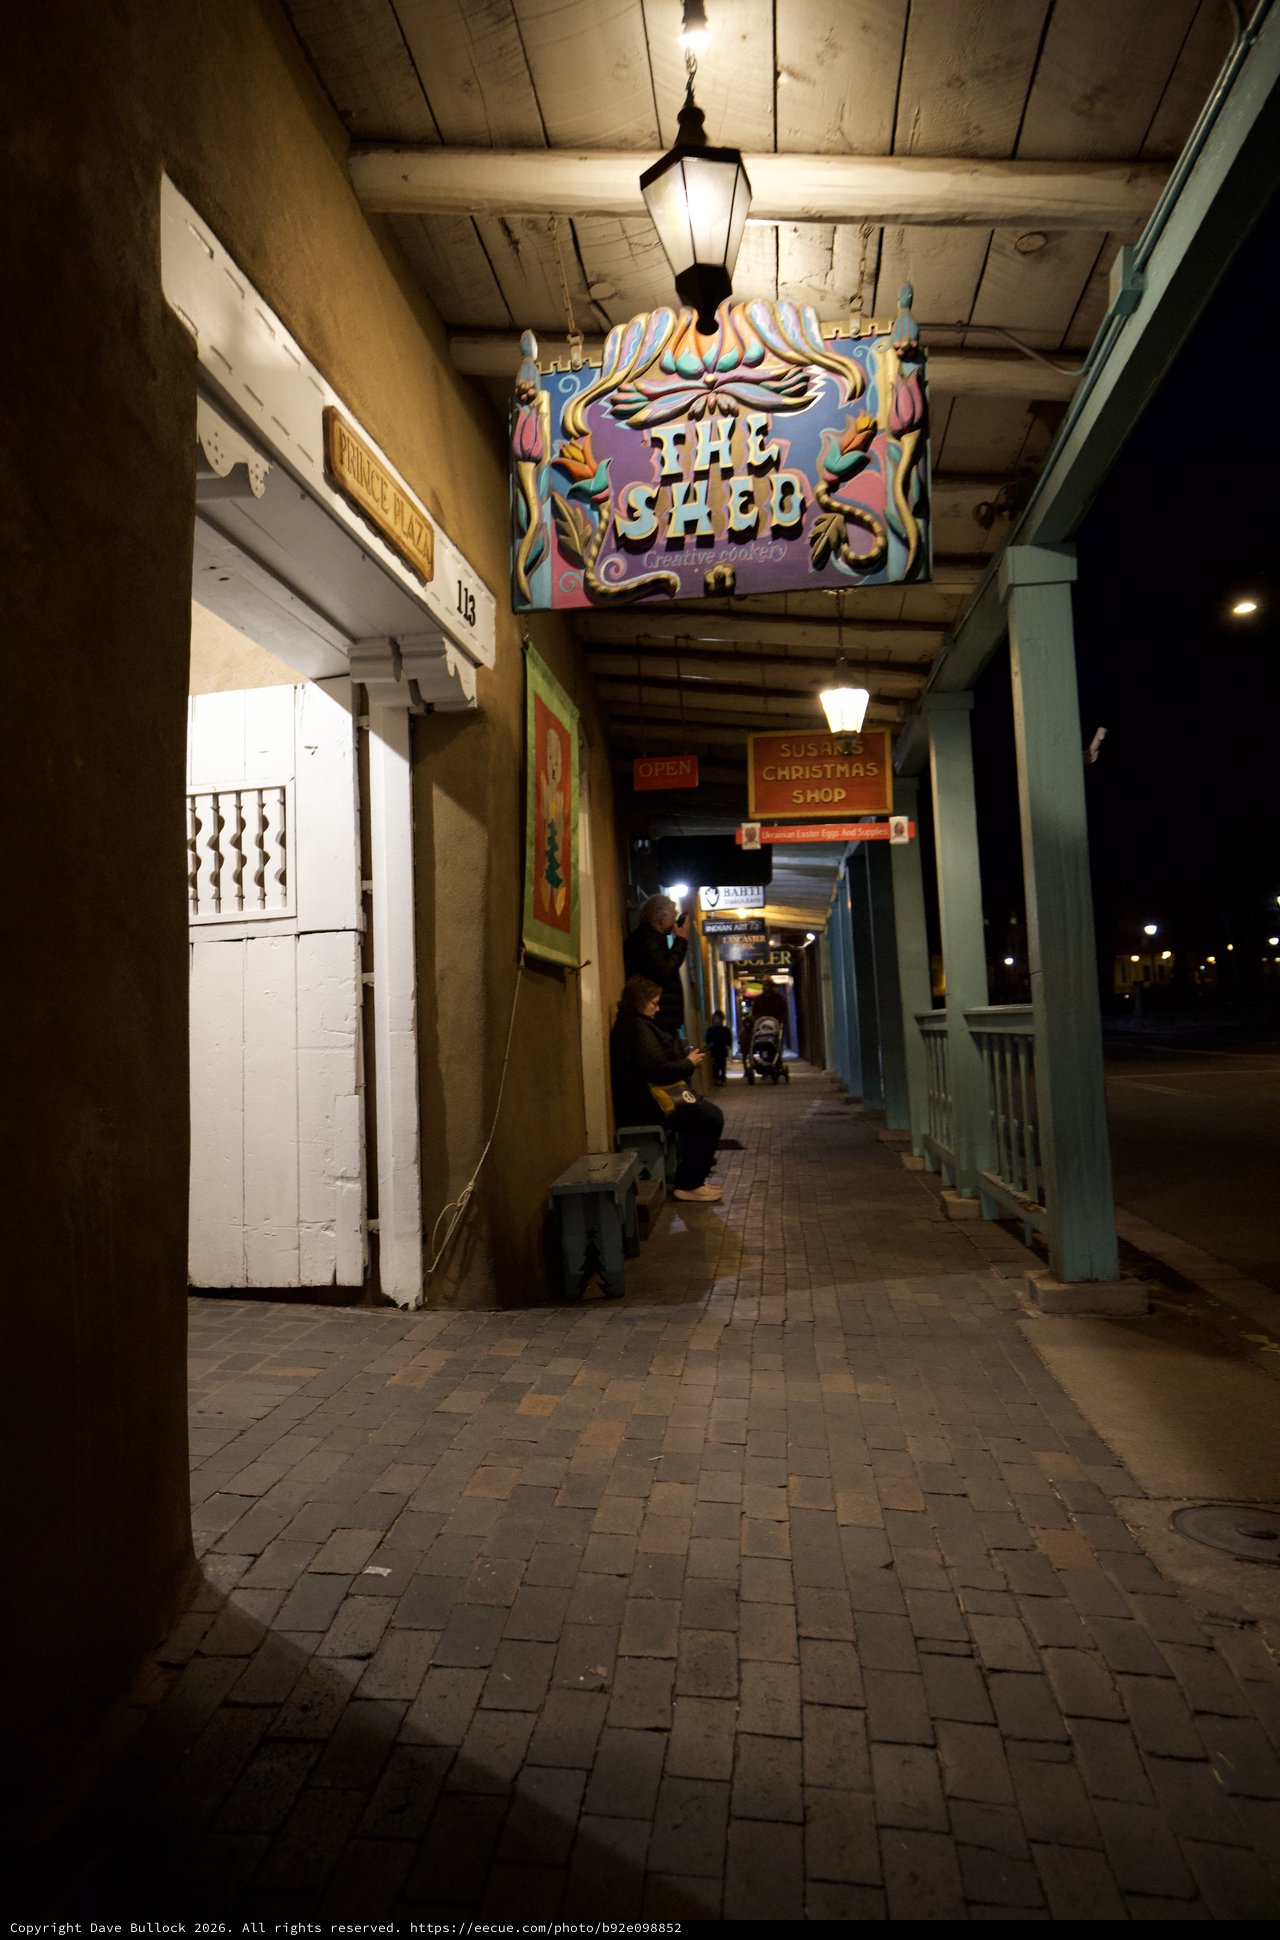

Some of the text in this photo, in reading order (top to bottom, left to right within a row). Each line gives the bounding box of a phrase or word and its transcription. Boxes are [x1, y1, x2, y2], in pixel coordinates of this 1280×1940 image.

[650, 412, 780, 478] THE
[338, 427, 433, 565] PRINCE PLAZA
[615, 473, 804, 543] SHED
[642, 541, 789, 569] Creative cookery
[457, 580, 476, 627] 113
[639, 759, 692, 778] OPEN
[762, 762, 879, 781] CHRISTMAS
[791, 788, 847, 804] SHOP
[762, 827, 888, 840] Ukrainian Easter Eggs And Supplies
[705, 924, 733, 933] INDIAN
